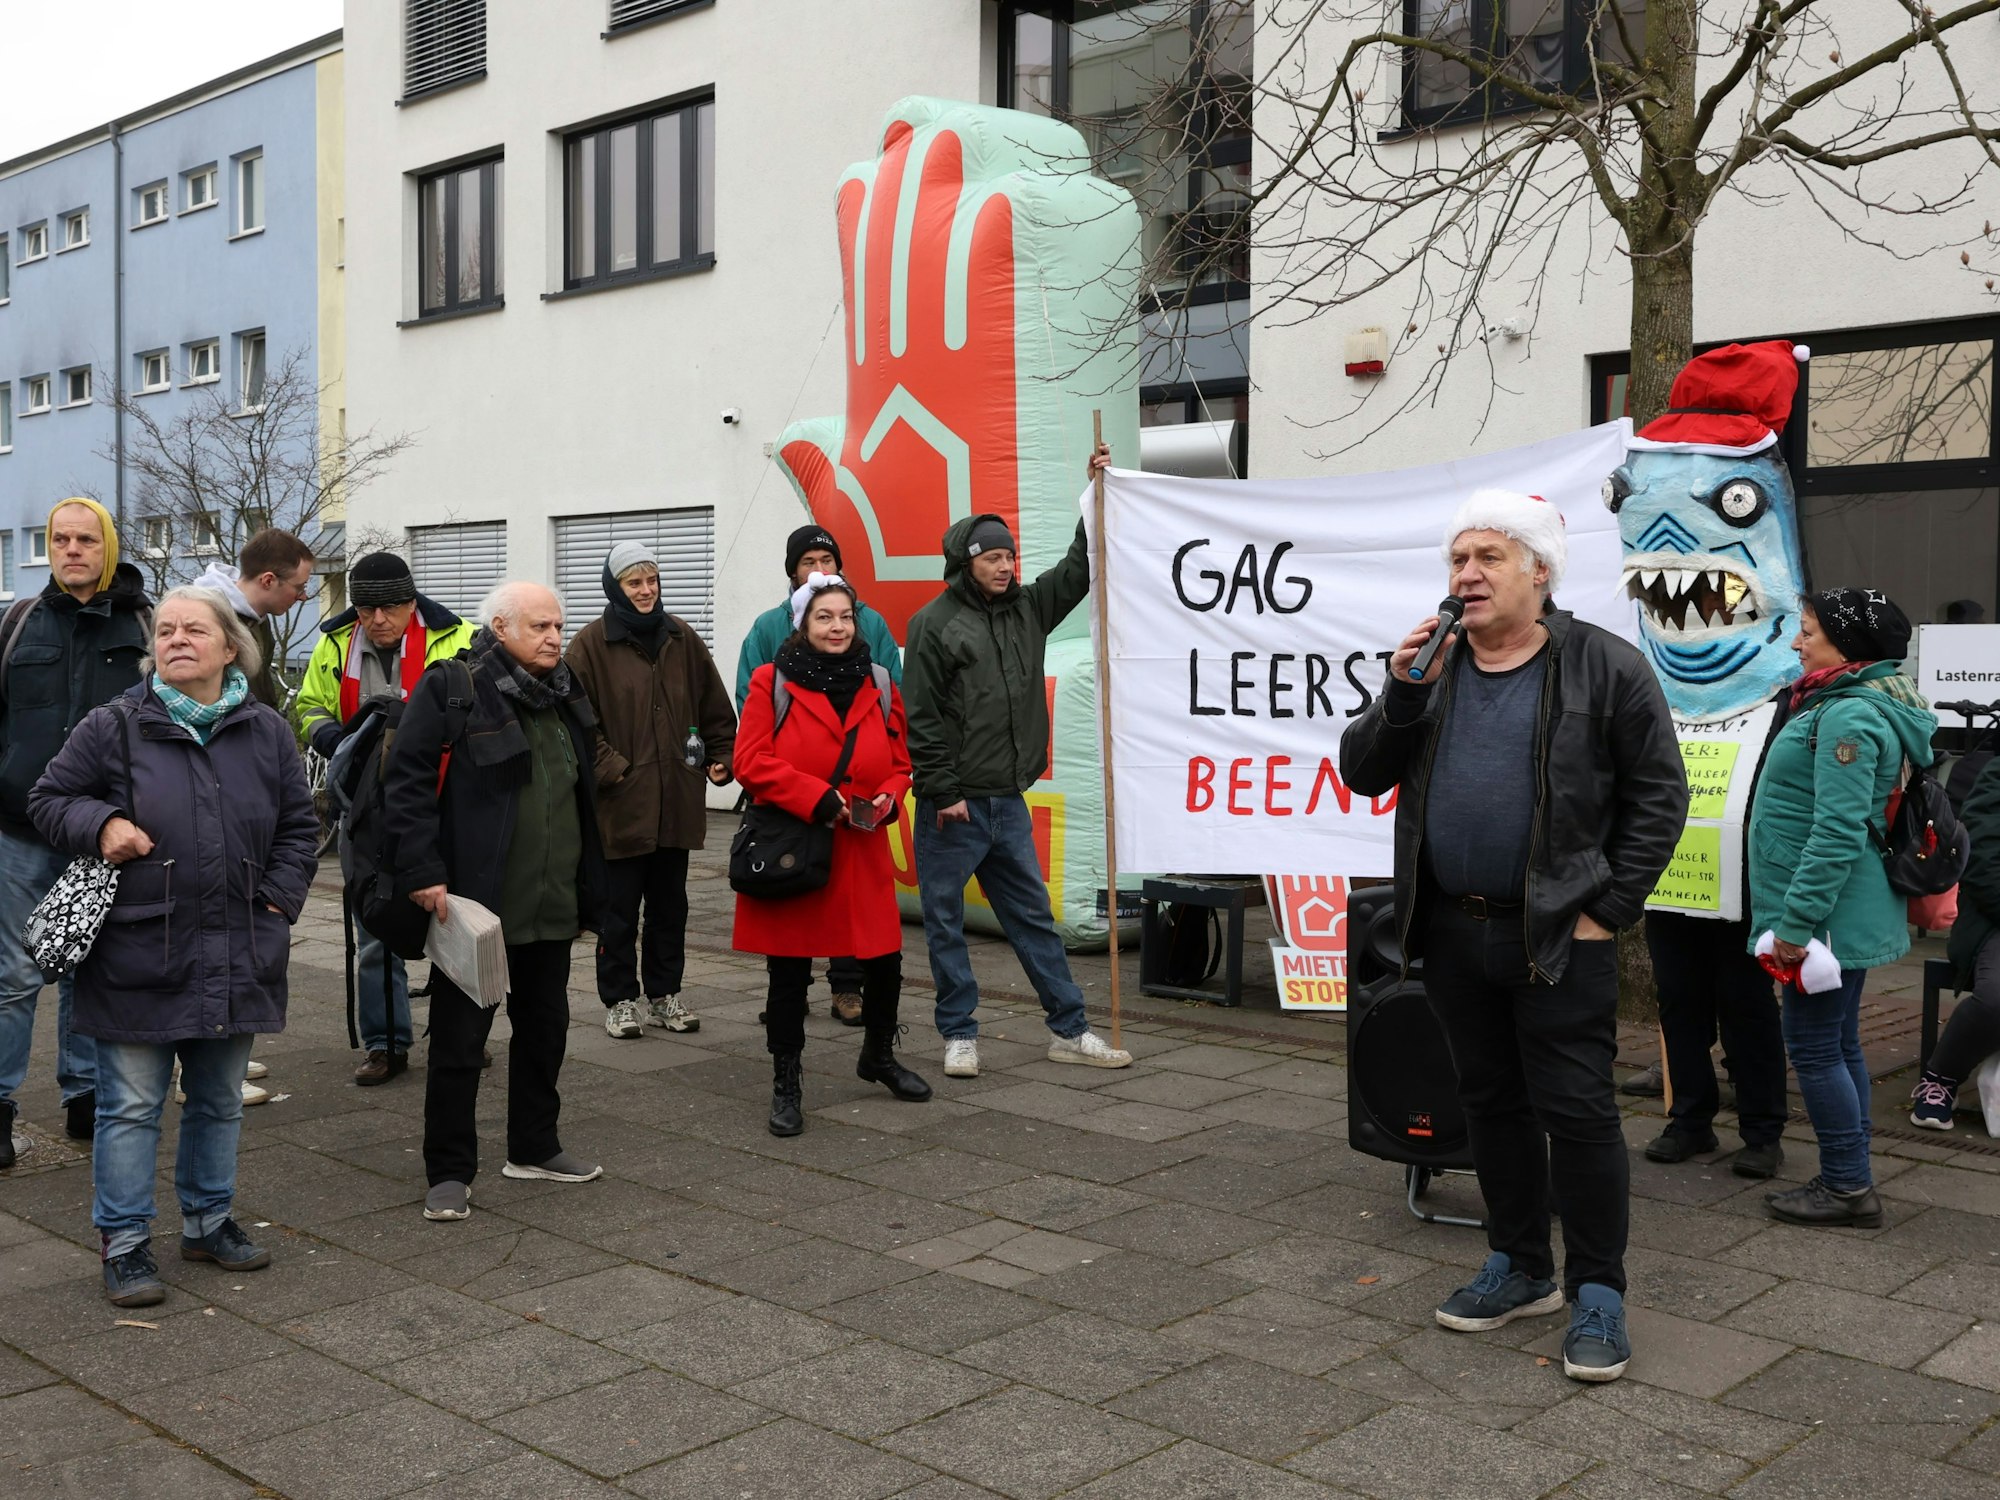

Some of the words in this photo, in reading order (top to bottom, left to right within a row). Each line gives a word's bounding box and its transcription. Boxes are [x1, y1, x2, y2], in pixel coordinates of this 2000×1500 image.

[1172, 538, 1313, 615] GAG
[1679, 743, 1719, 756] ER:
[1672, 852, 1708, 863] USER
[1286, 980, 1347, 1003] STOP
